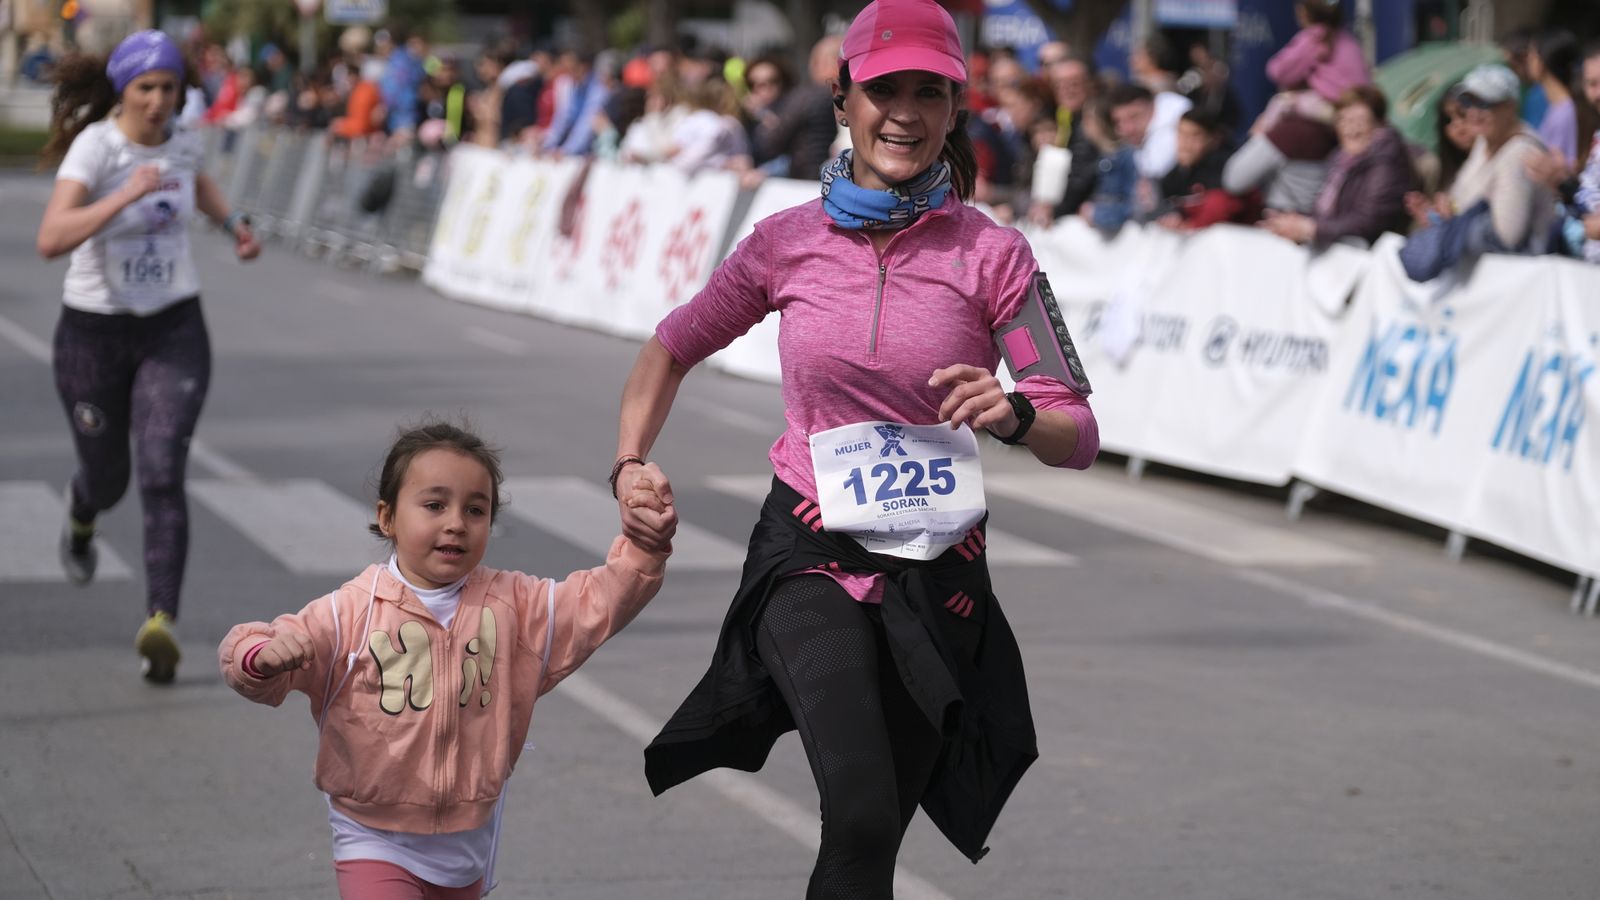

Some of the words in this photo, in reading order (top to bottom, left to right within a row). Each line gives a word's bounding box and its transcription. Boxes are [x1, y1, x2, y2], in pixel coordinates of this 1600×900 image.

[835, 442, 872, 456] MUJER
[843, 457, 956, 506] 1225
[882, 497, 929, 512] SORAYA
[368, 606, 497, 715] Hi!
